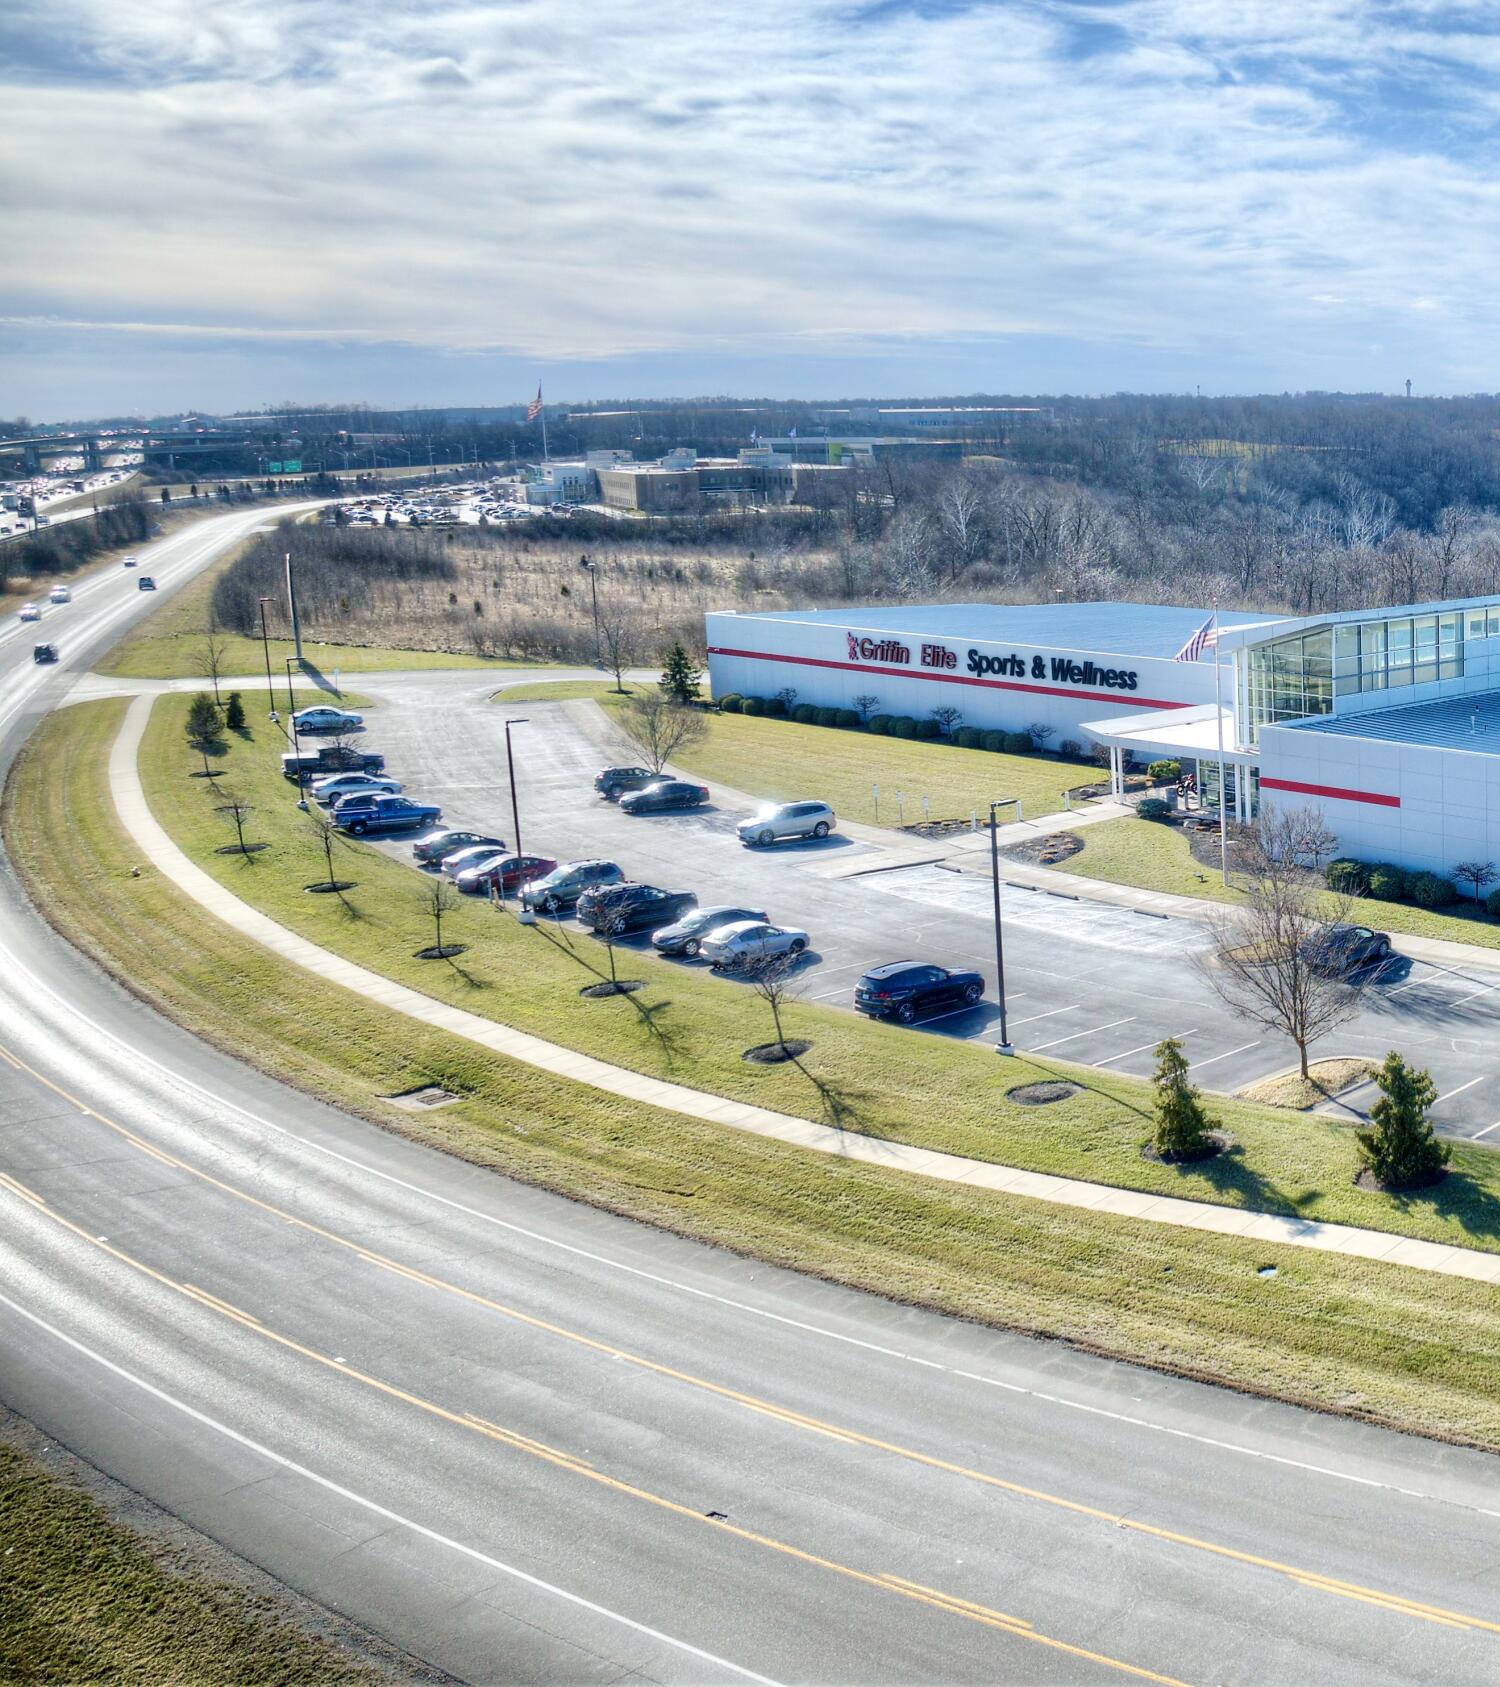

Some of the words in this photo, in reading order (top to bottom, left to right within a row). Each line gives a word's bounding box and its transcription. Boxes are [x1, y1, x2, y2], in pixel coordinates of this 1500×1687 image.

[860, 637, 910, 665] Griffin
[920, 643, 957, 670] Elite
[967, 648, 1025, 678] Sports
[1031, 655, 1047, 680] &
[1050, 657, 1138, 691] Wellness
